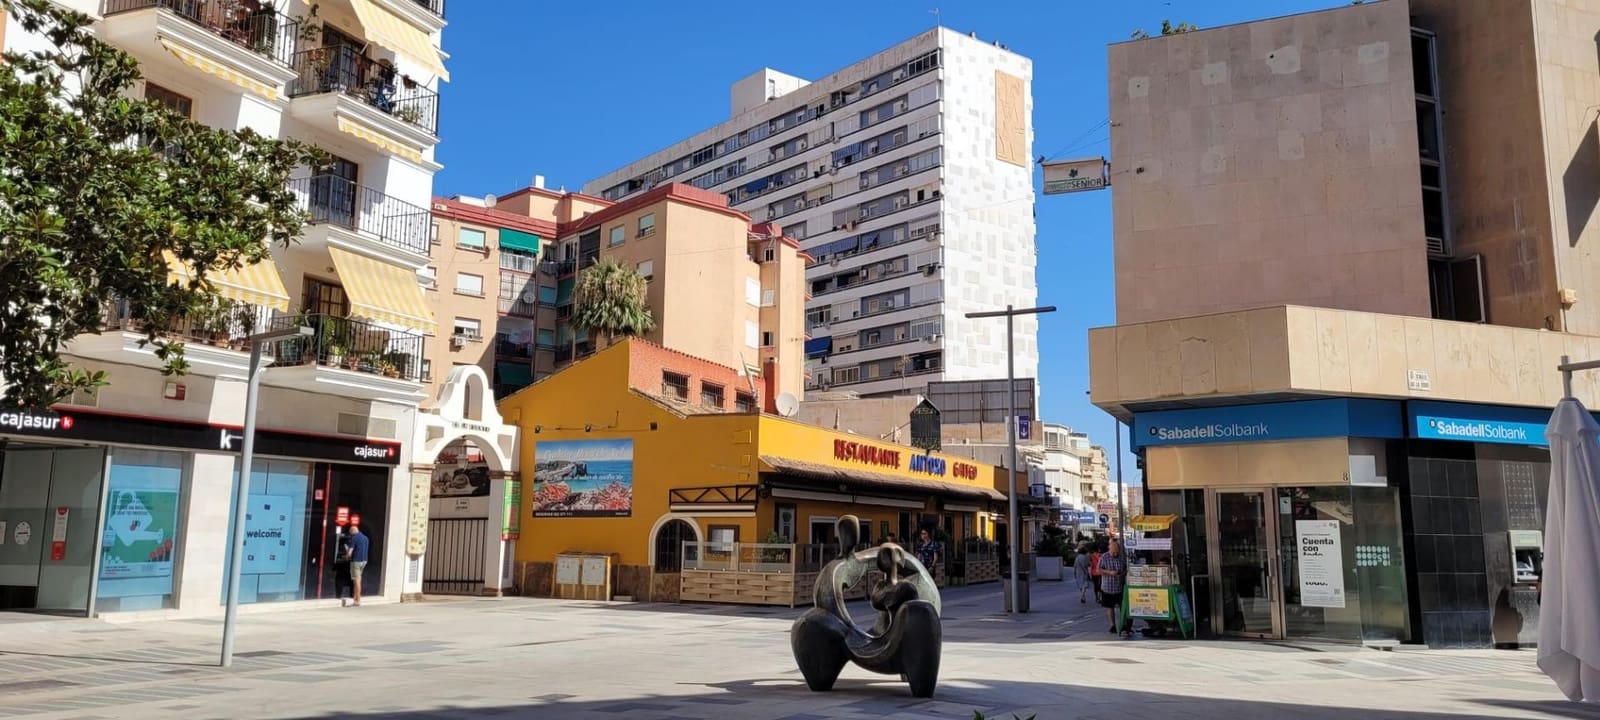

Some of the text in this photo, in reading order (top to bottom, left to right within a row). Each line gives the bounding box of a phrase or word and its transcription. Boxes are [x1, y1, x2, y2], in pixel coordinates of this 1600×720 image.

[0, 412, 60, 430] cajasur
[1437, 420, 1527, 440] SabadellSolbank
[1158, 422, 1269, 440] SabadellSolbank
[354, 444, 388, 459] cajasur
[833, 438, 901, 469] RESTAURANTE
[246, 529, 282, 538] welcome
[1302, 537, 1334, 545] Cuenta
